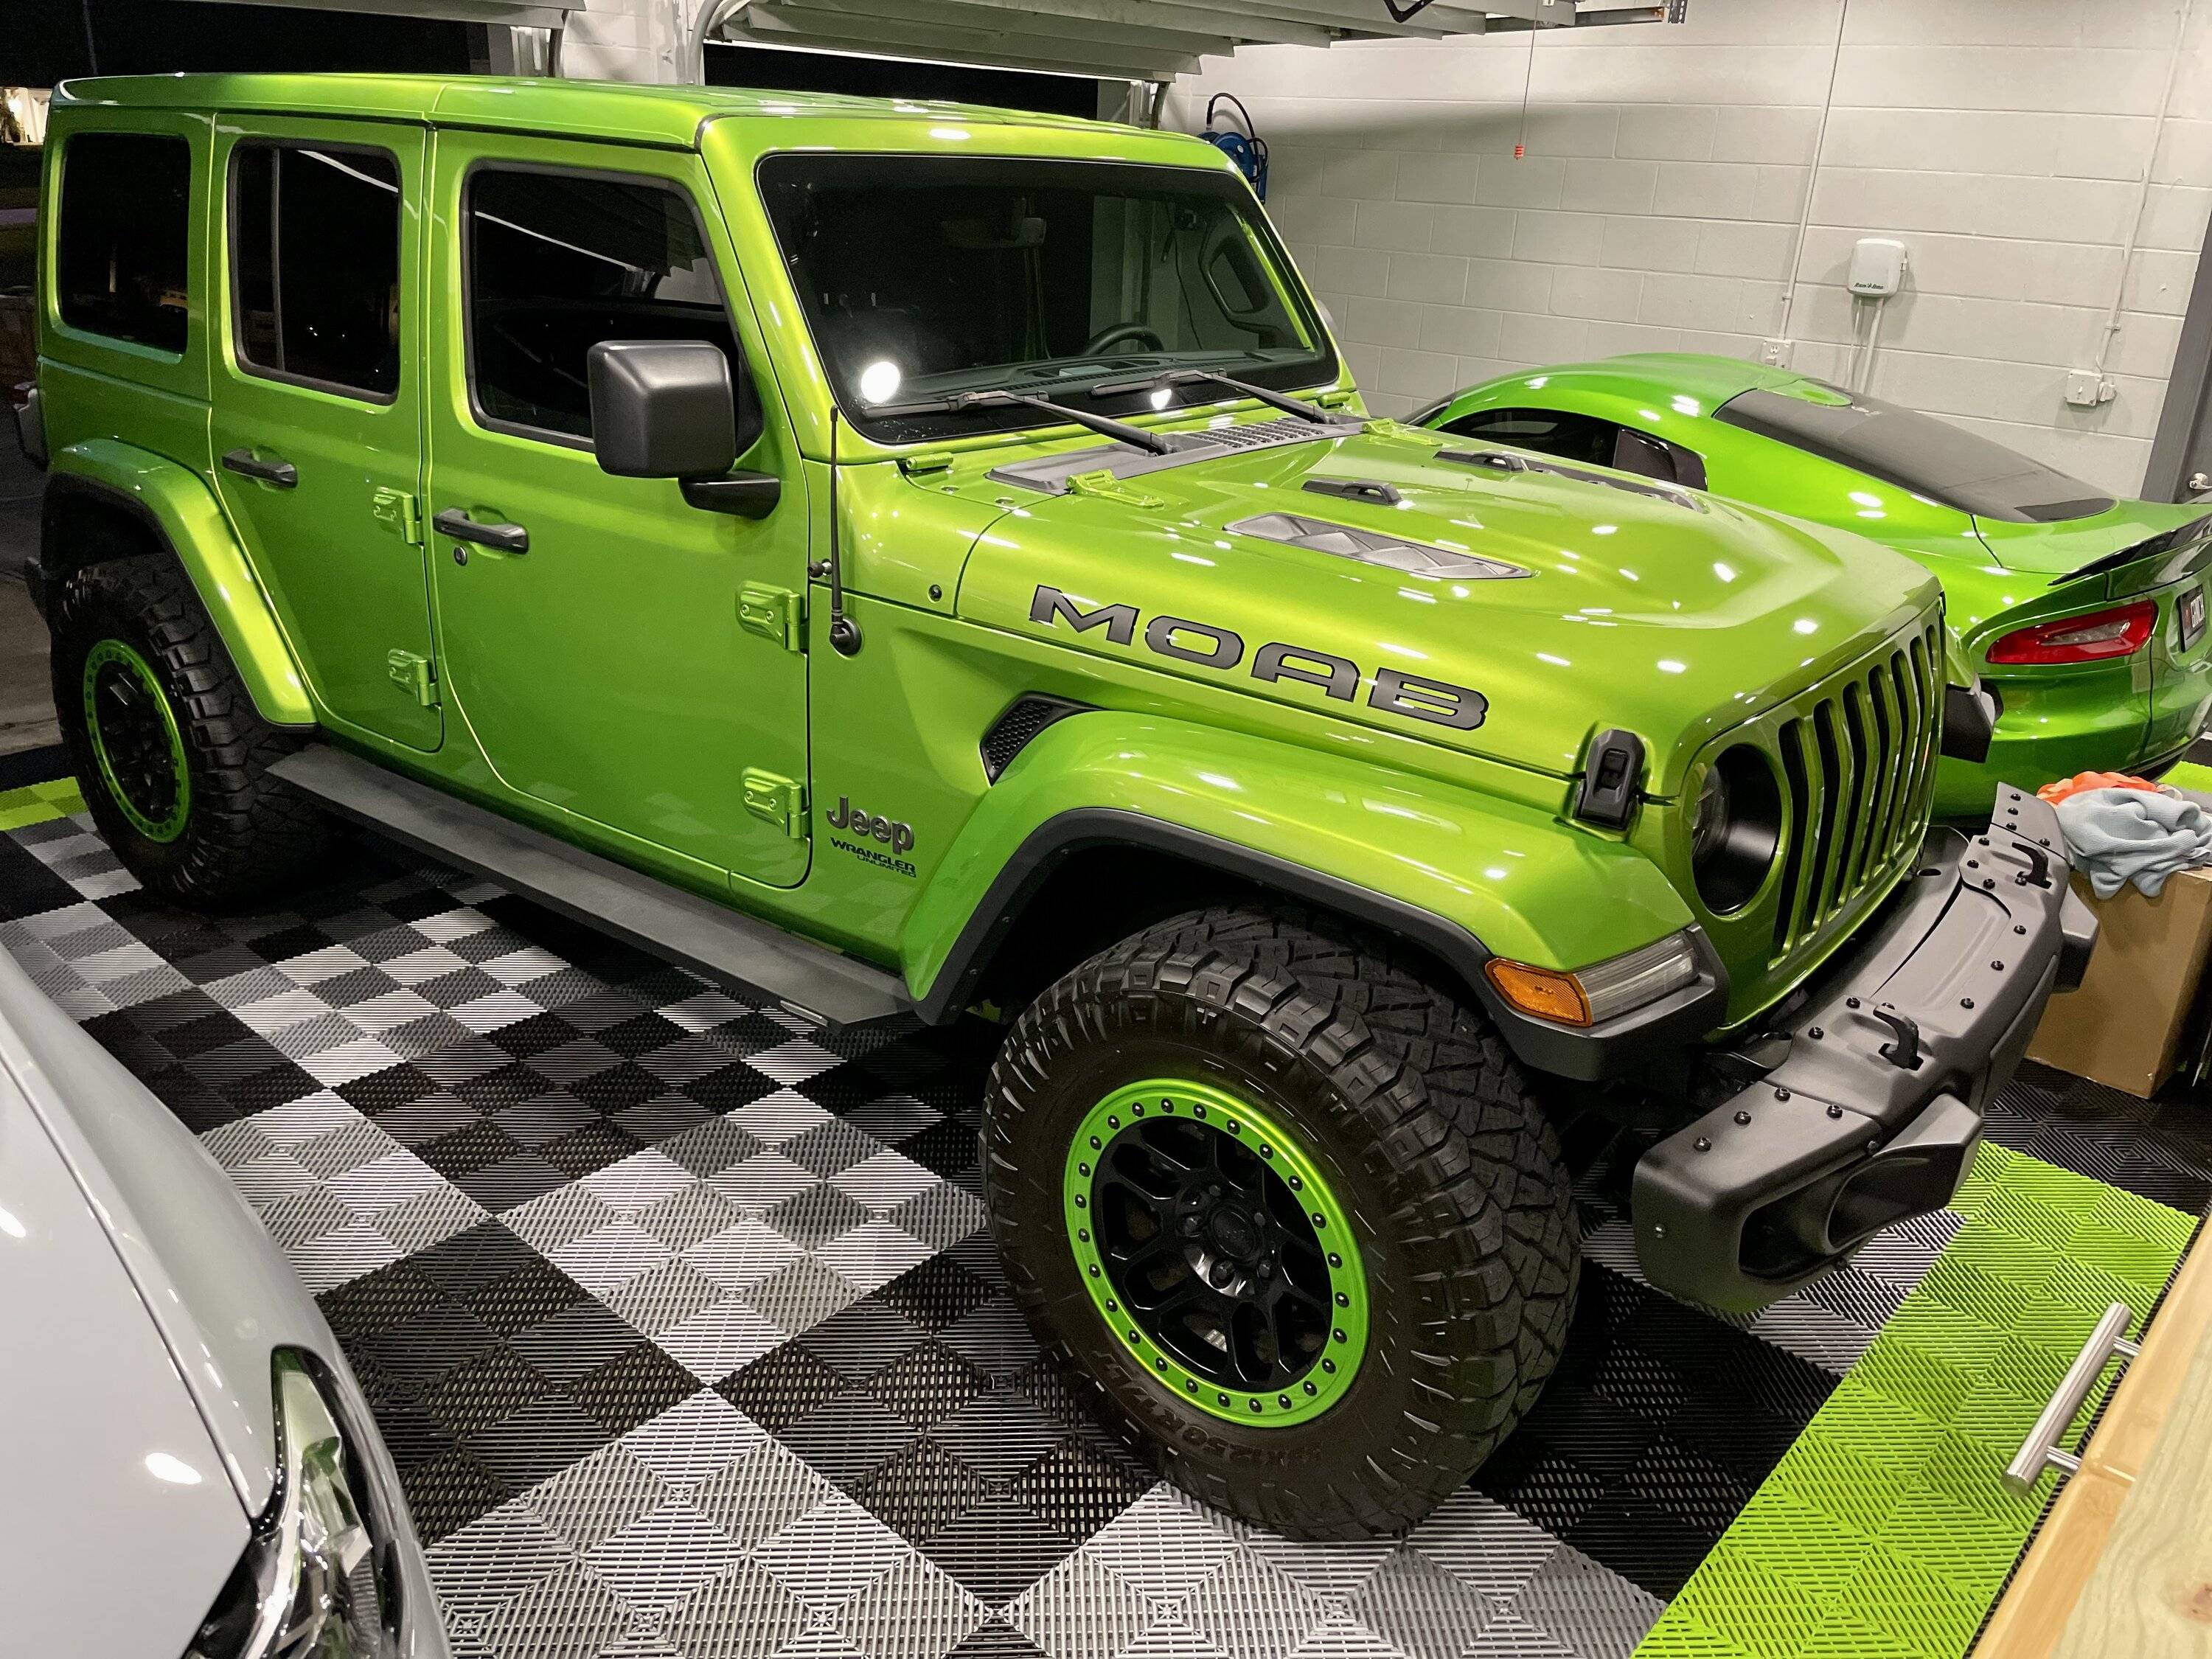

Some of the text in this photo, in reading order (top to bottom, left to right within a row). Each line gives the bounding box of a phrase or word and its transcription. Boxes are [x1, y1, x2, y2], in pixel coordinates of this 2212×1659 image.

[1029, 584, 1489, 731] MOAB
[826, 796, 915, 855] Jeep
[830, 837, 916, 874] WRANGLER
[857, 855, 917, 878] UNLIMITED
